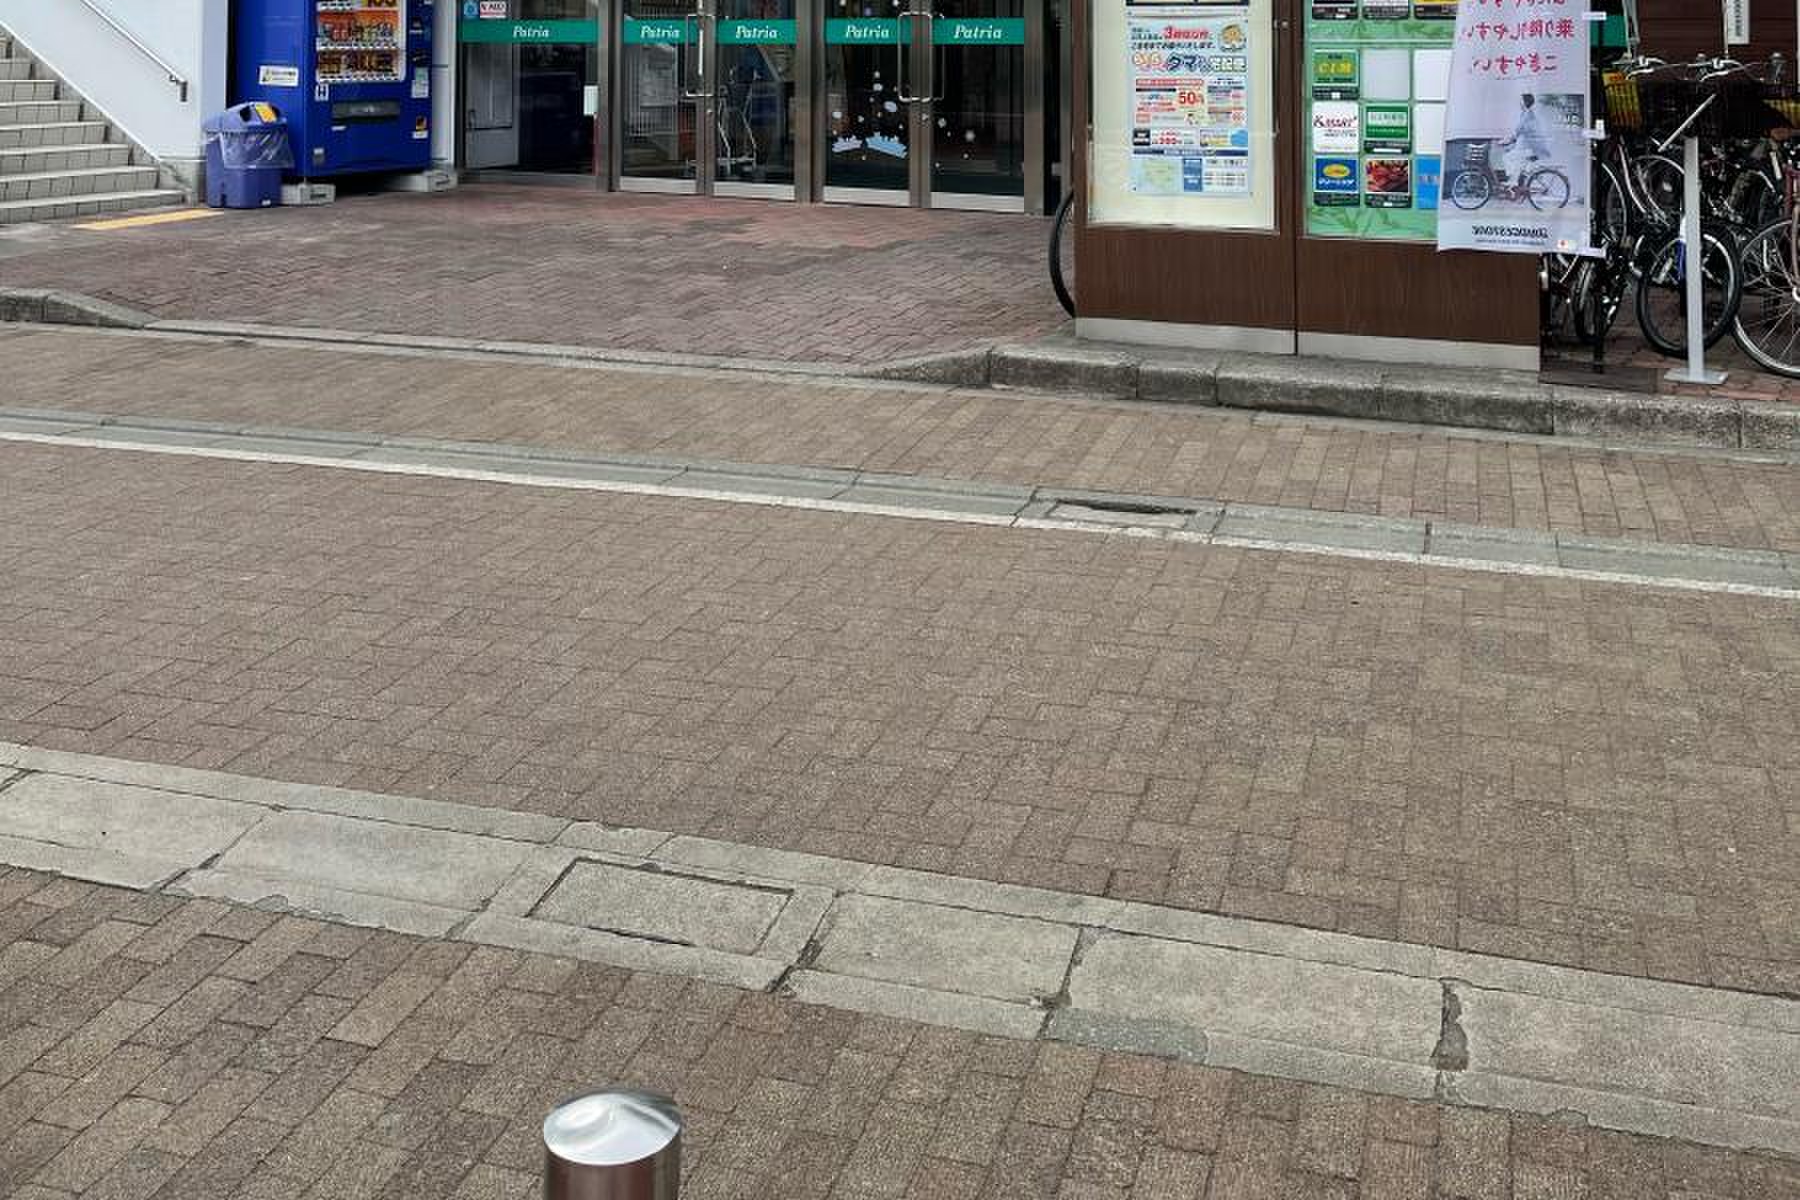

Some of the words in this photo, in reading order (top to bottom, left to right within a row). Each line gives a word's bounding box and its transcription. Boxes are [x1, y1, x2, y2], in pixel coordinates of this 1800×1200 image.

[512, 25, 550, 39] Patria
[640, 25, 680, 40] Patria
[735, 25, 778, 40] Patria
[845, 24, 890, 40] Patria
[953, 24, 1003, 40] Patria
